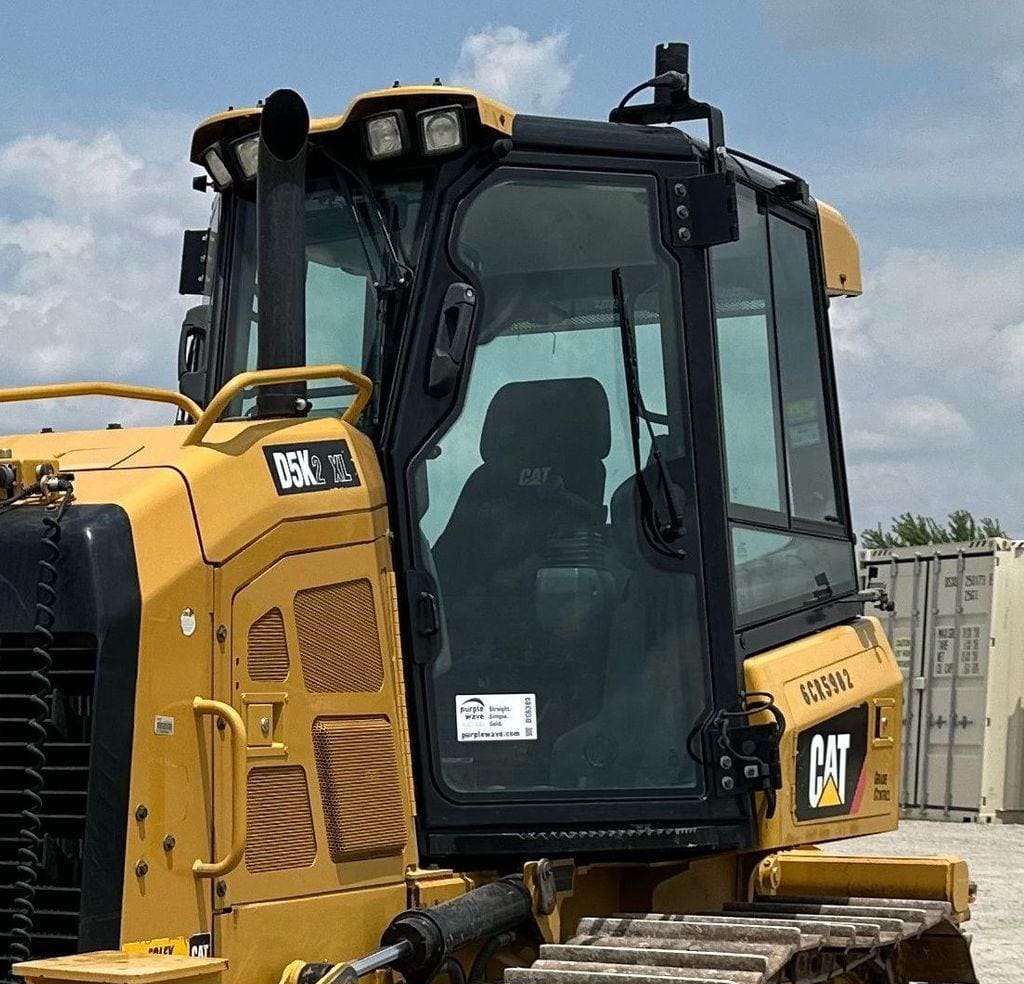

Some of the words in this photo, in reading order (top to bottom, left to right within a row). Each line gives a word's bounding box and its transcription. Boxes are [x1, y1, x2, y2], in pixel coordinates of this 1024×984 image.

[272, 450, 326, 489] D5K2
[327, 453, 353, 483] XL
[519, 466, 552, 486] CAT
[460, 705, 484, 714] purple
[461, 730, 520, 739] purplewave.com
[808, 733, 851, 808] CAT
[191, 945, 209, 957] CAT
